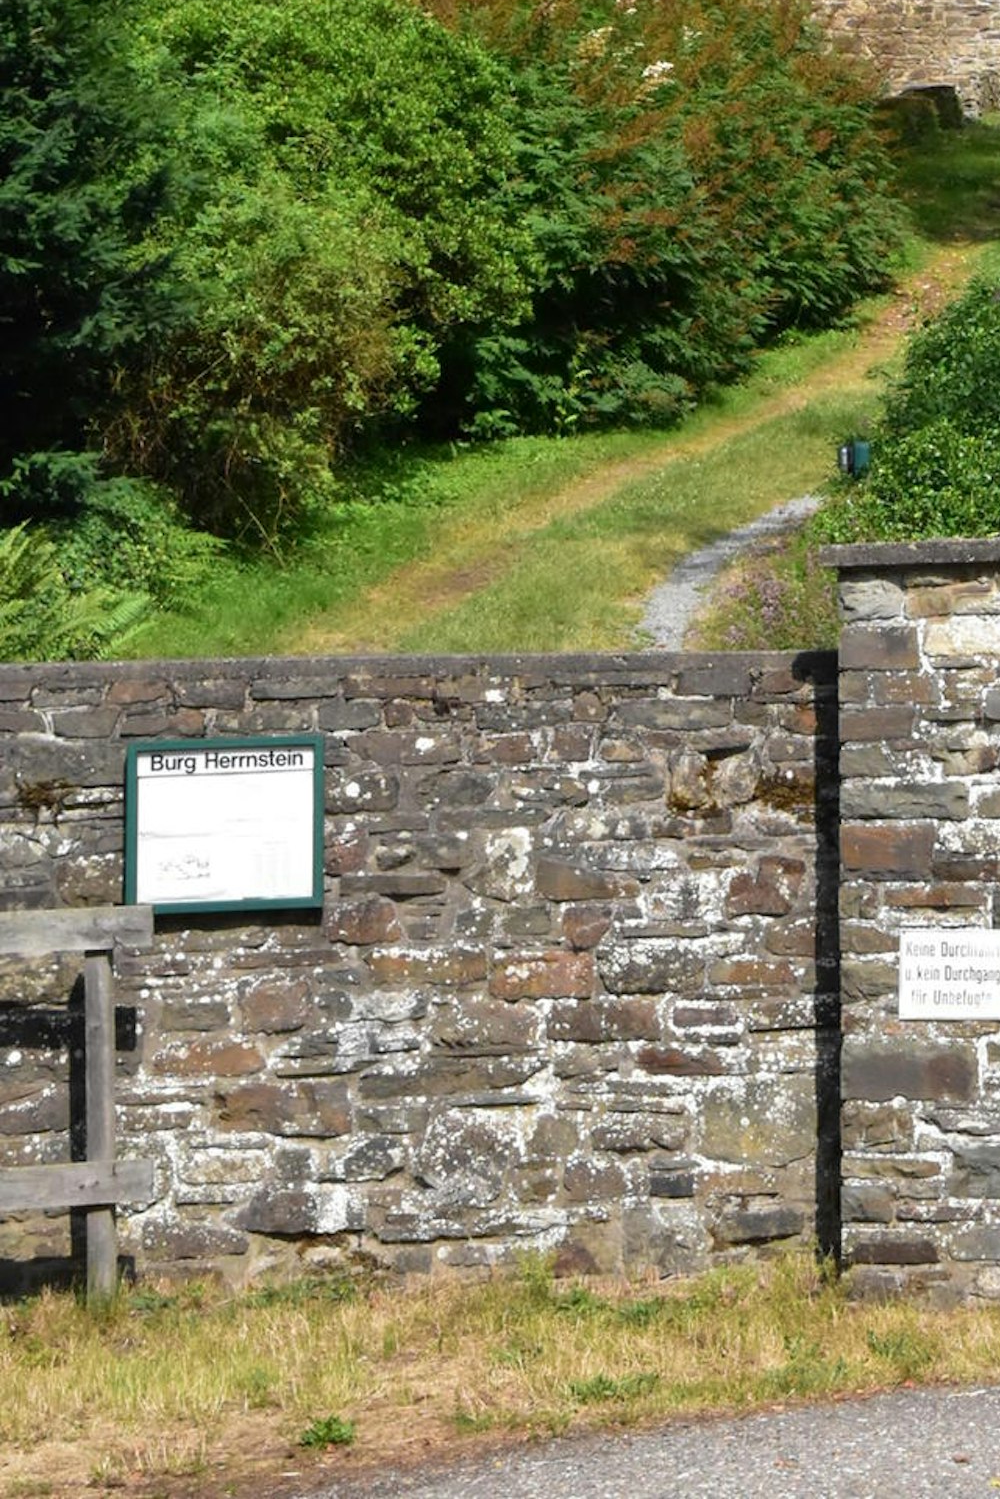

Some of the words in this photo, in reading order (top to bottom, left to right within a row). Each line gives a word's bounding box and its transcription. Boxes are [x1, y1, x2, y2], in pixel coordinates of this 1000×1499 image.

[151, 754, 196, 774] Burg
[205, 750, 304, 769] Herrnstein
[905, 941, 936, 957] Keine
[941, 941, 1000, 957] Durchat
[916, 964, 941, 981] kein
